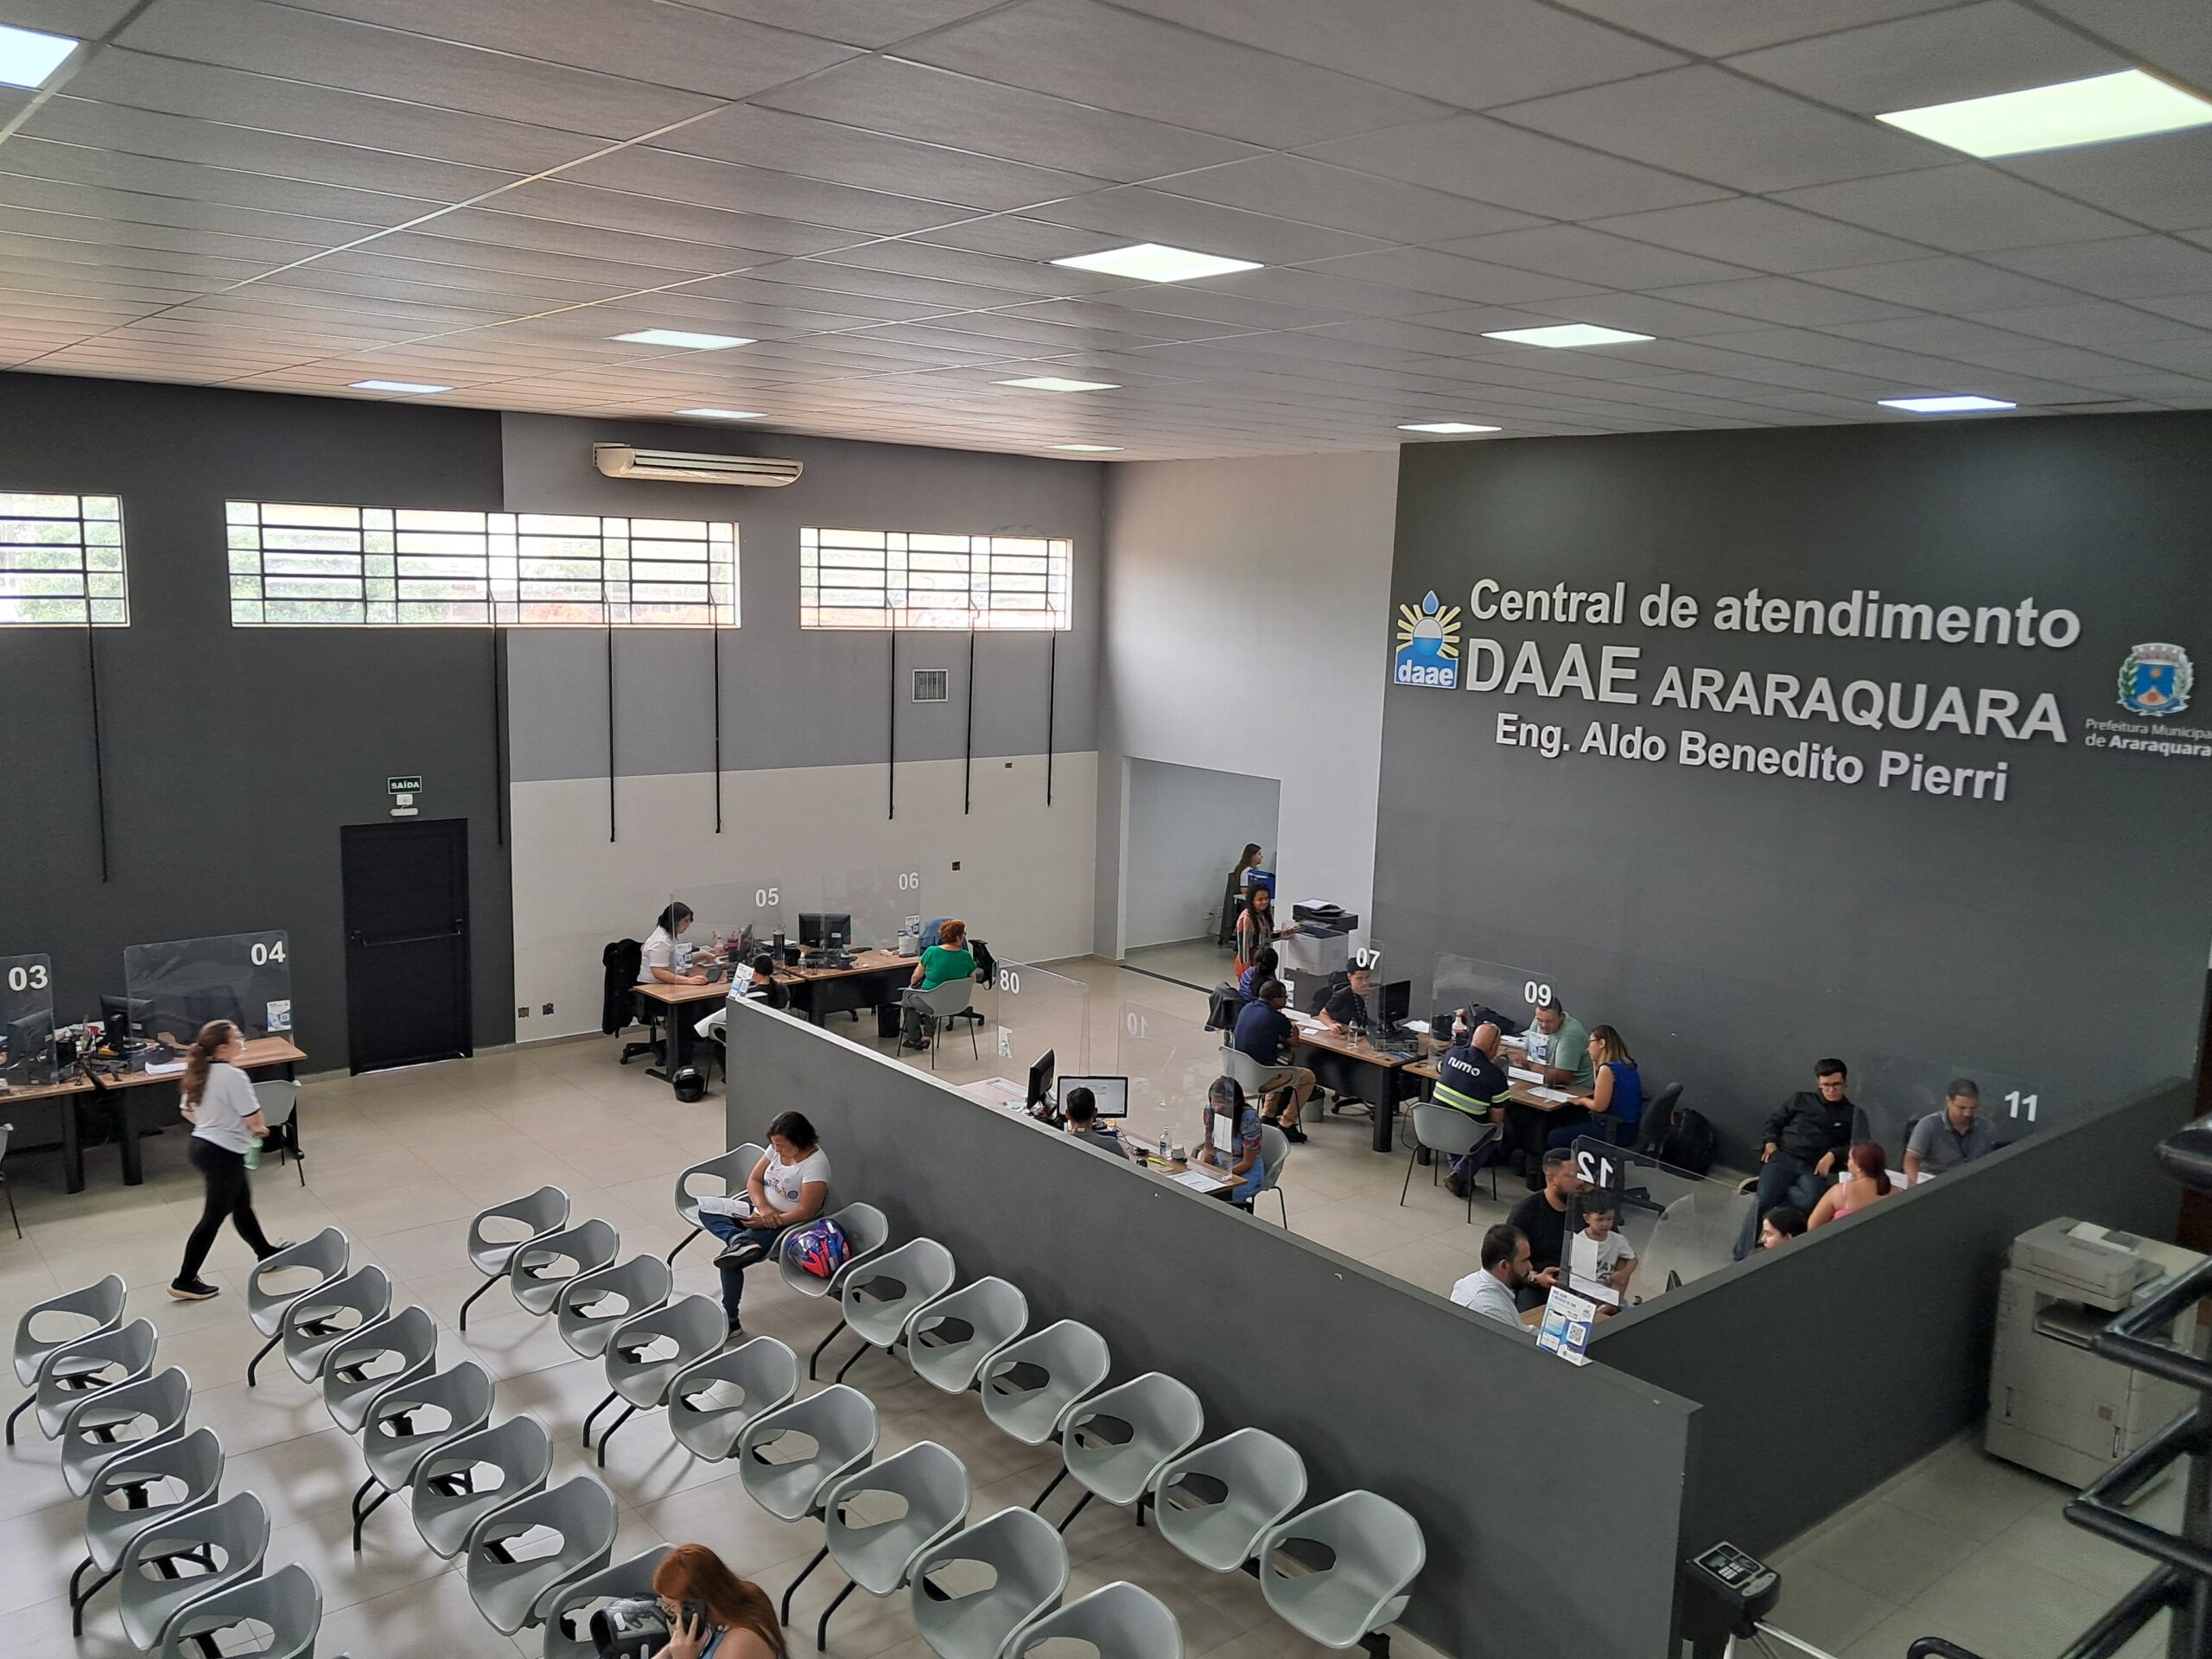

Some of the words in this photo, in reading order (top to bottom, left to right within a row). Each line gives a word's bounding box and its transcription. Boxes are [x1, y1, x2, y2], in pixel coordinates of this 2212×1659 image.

[1471, 579, 1626, 624] Central
[1639, 583, 1699, 628] de
[1713, 589, 2081, 648] atendimento
[1398, 659, 1454, 686] daae
[1466, 638, 1641, 704] DAAE
[1651, 666, 2068, 743] ARARAQUARA
[2085, 718, 2149, 734] Prefeitura
[2151, 724, 2212, 741] Municipa
[1496, 713, 1571, 758] Eng.
[1580, 721, 1667, 761] Aldo
[1679, 730, 1864, 785] Benedito
[1878, 750, 2009, 802] Pierri
[2085, 733, 2107, 747] de
[2108, 734, 2212, 757] Araraquara
[391, 780, 420, 790] SAÍDA
[898, 873, 919, 891] 06
[754, 887, 779, 908] 05
[251, 941, 286, 966] 04
[1356, 947, 1381, 970] 07
[8, 965, 48, 992] 03
[1524, 981, 1552, 1007] 09
[1447, 1056, 1481, 1077] rumo
[2004, 1090, 2038, 1122] 11
